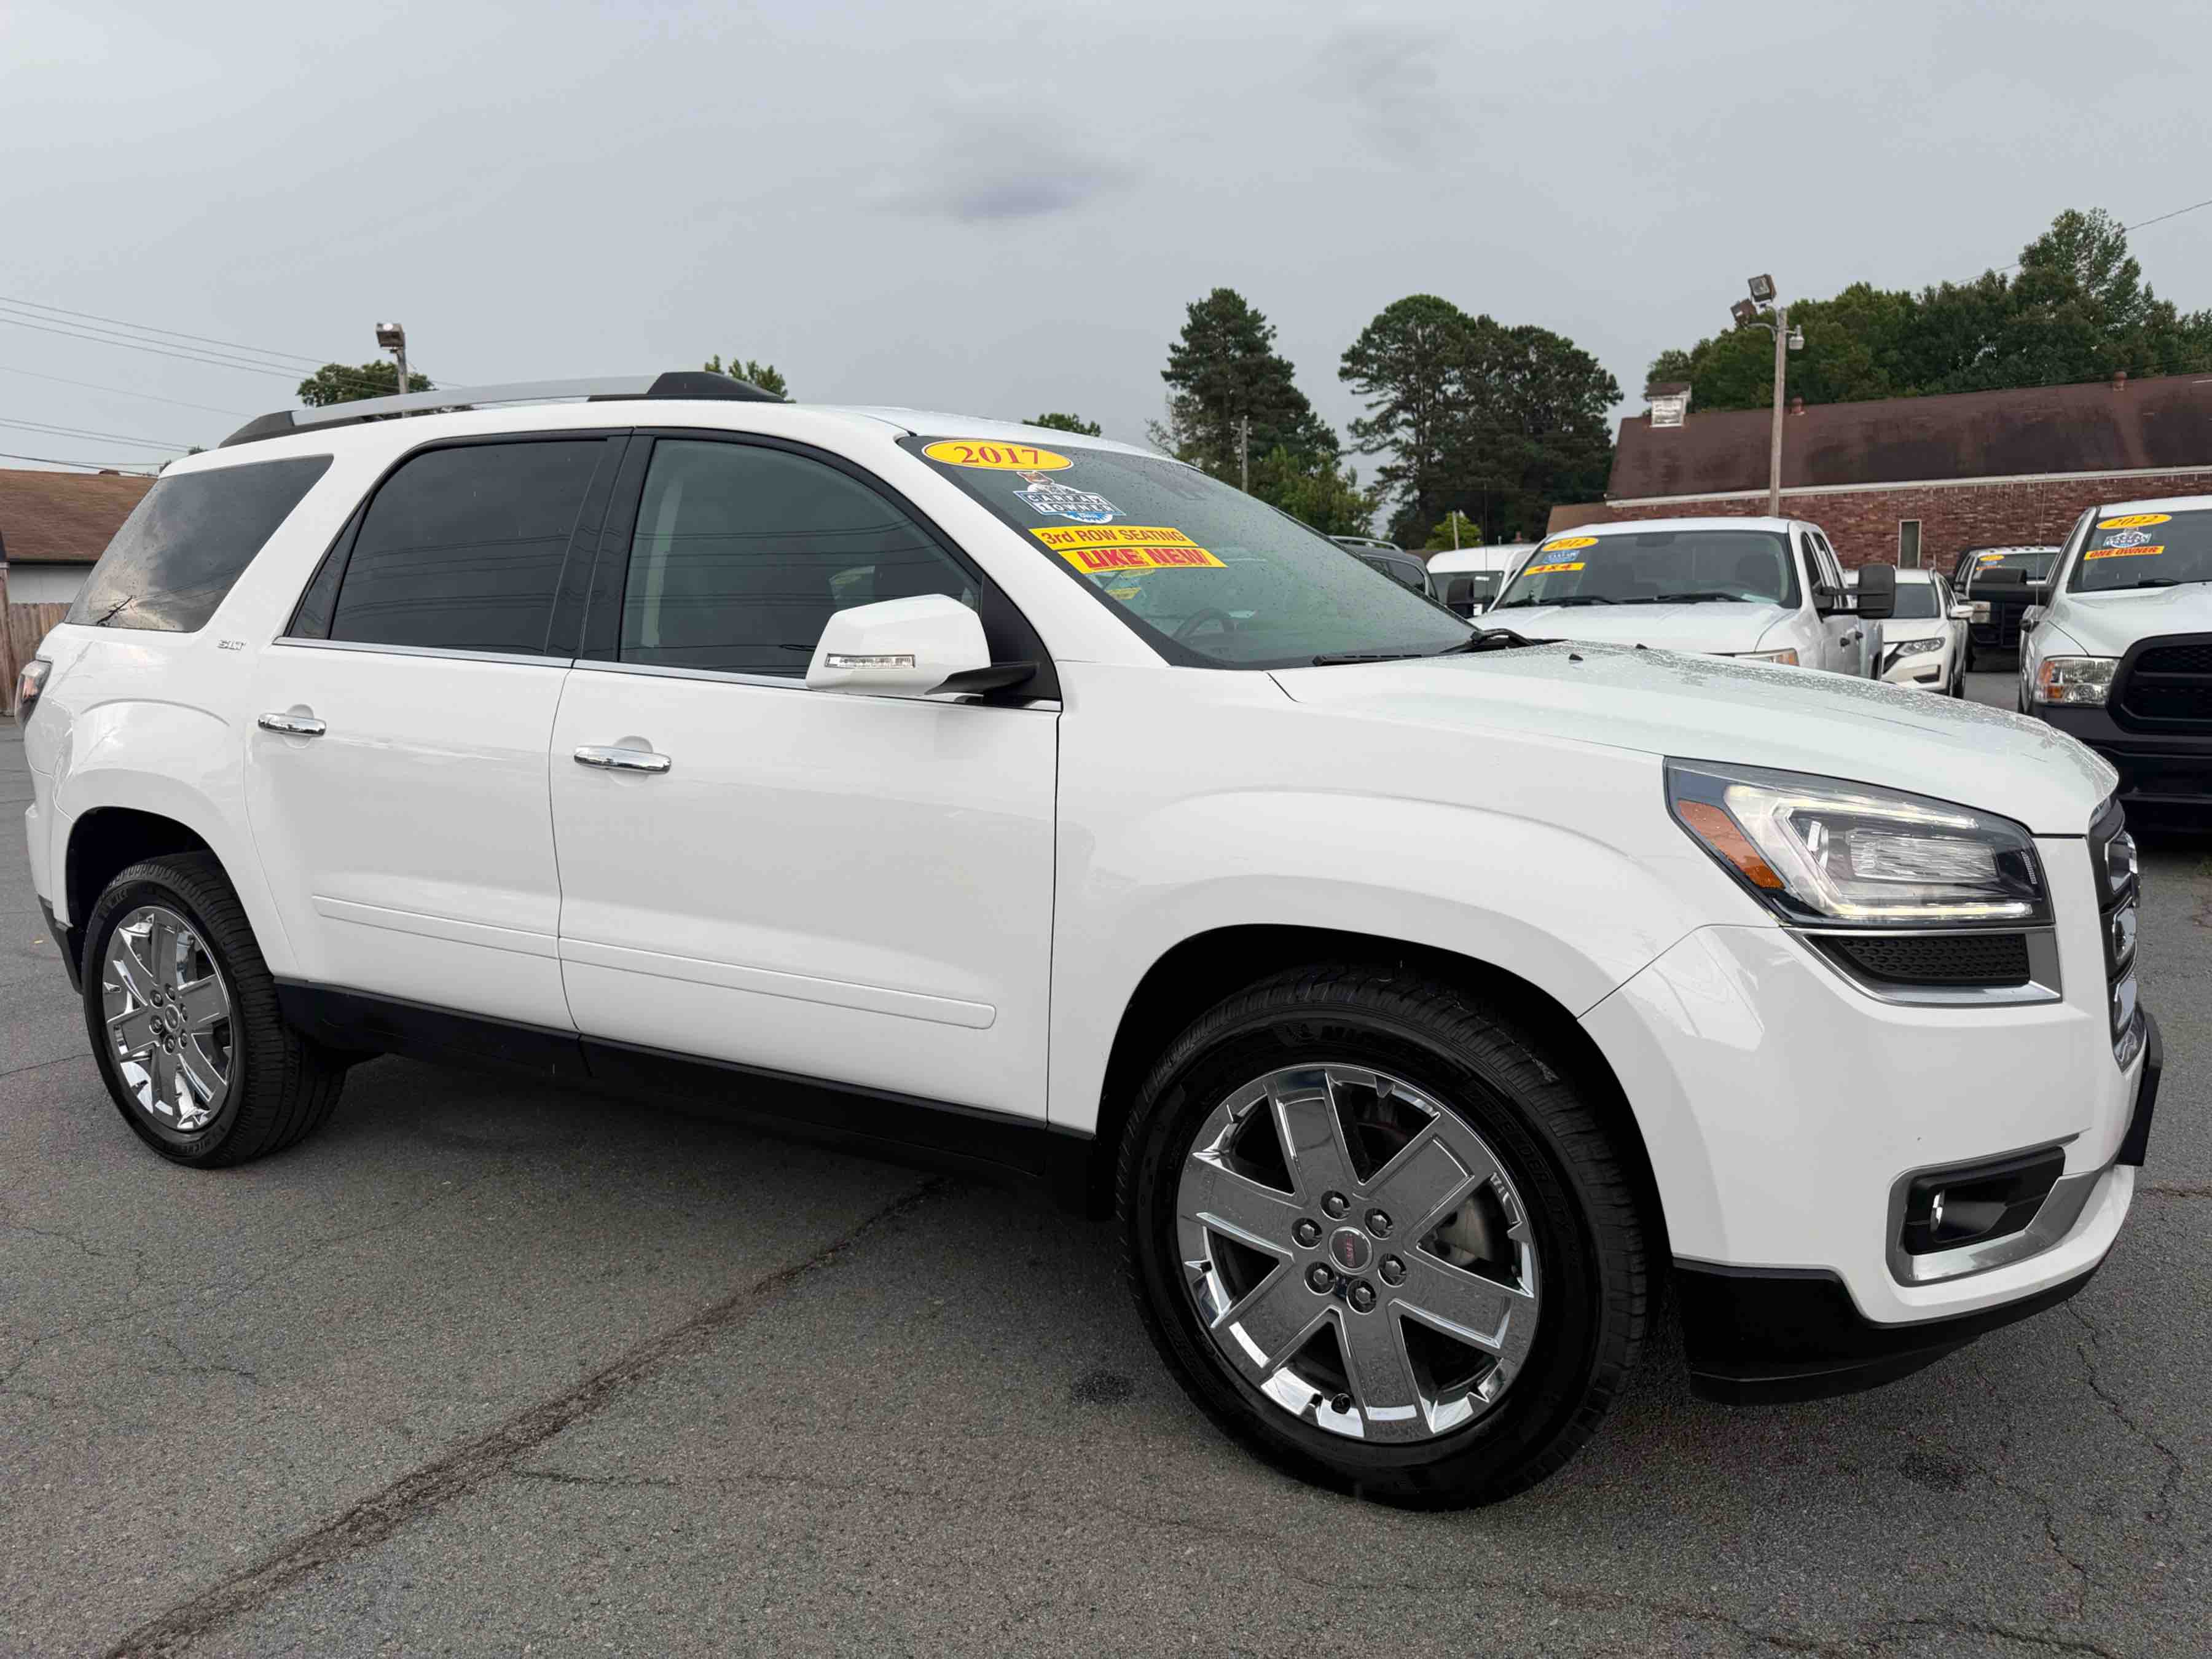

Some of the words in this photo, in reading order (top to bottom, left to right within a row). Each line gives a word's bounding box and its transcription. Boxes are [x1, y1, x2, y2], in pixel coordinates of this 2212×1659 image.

[953, 446, 1038, 464] 2017
[1041, 530, 1075, 544] 3rd
[1075, 530, 1119, 541] ROW
[1118, 530, 1187, 541] SEATING
[1077, 549, 1147, 569] LIKE
[1144, 548, 1212, 566] NEW
[216, 638, 248, 651] SLT
